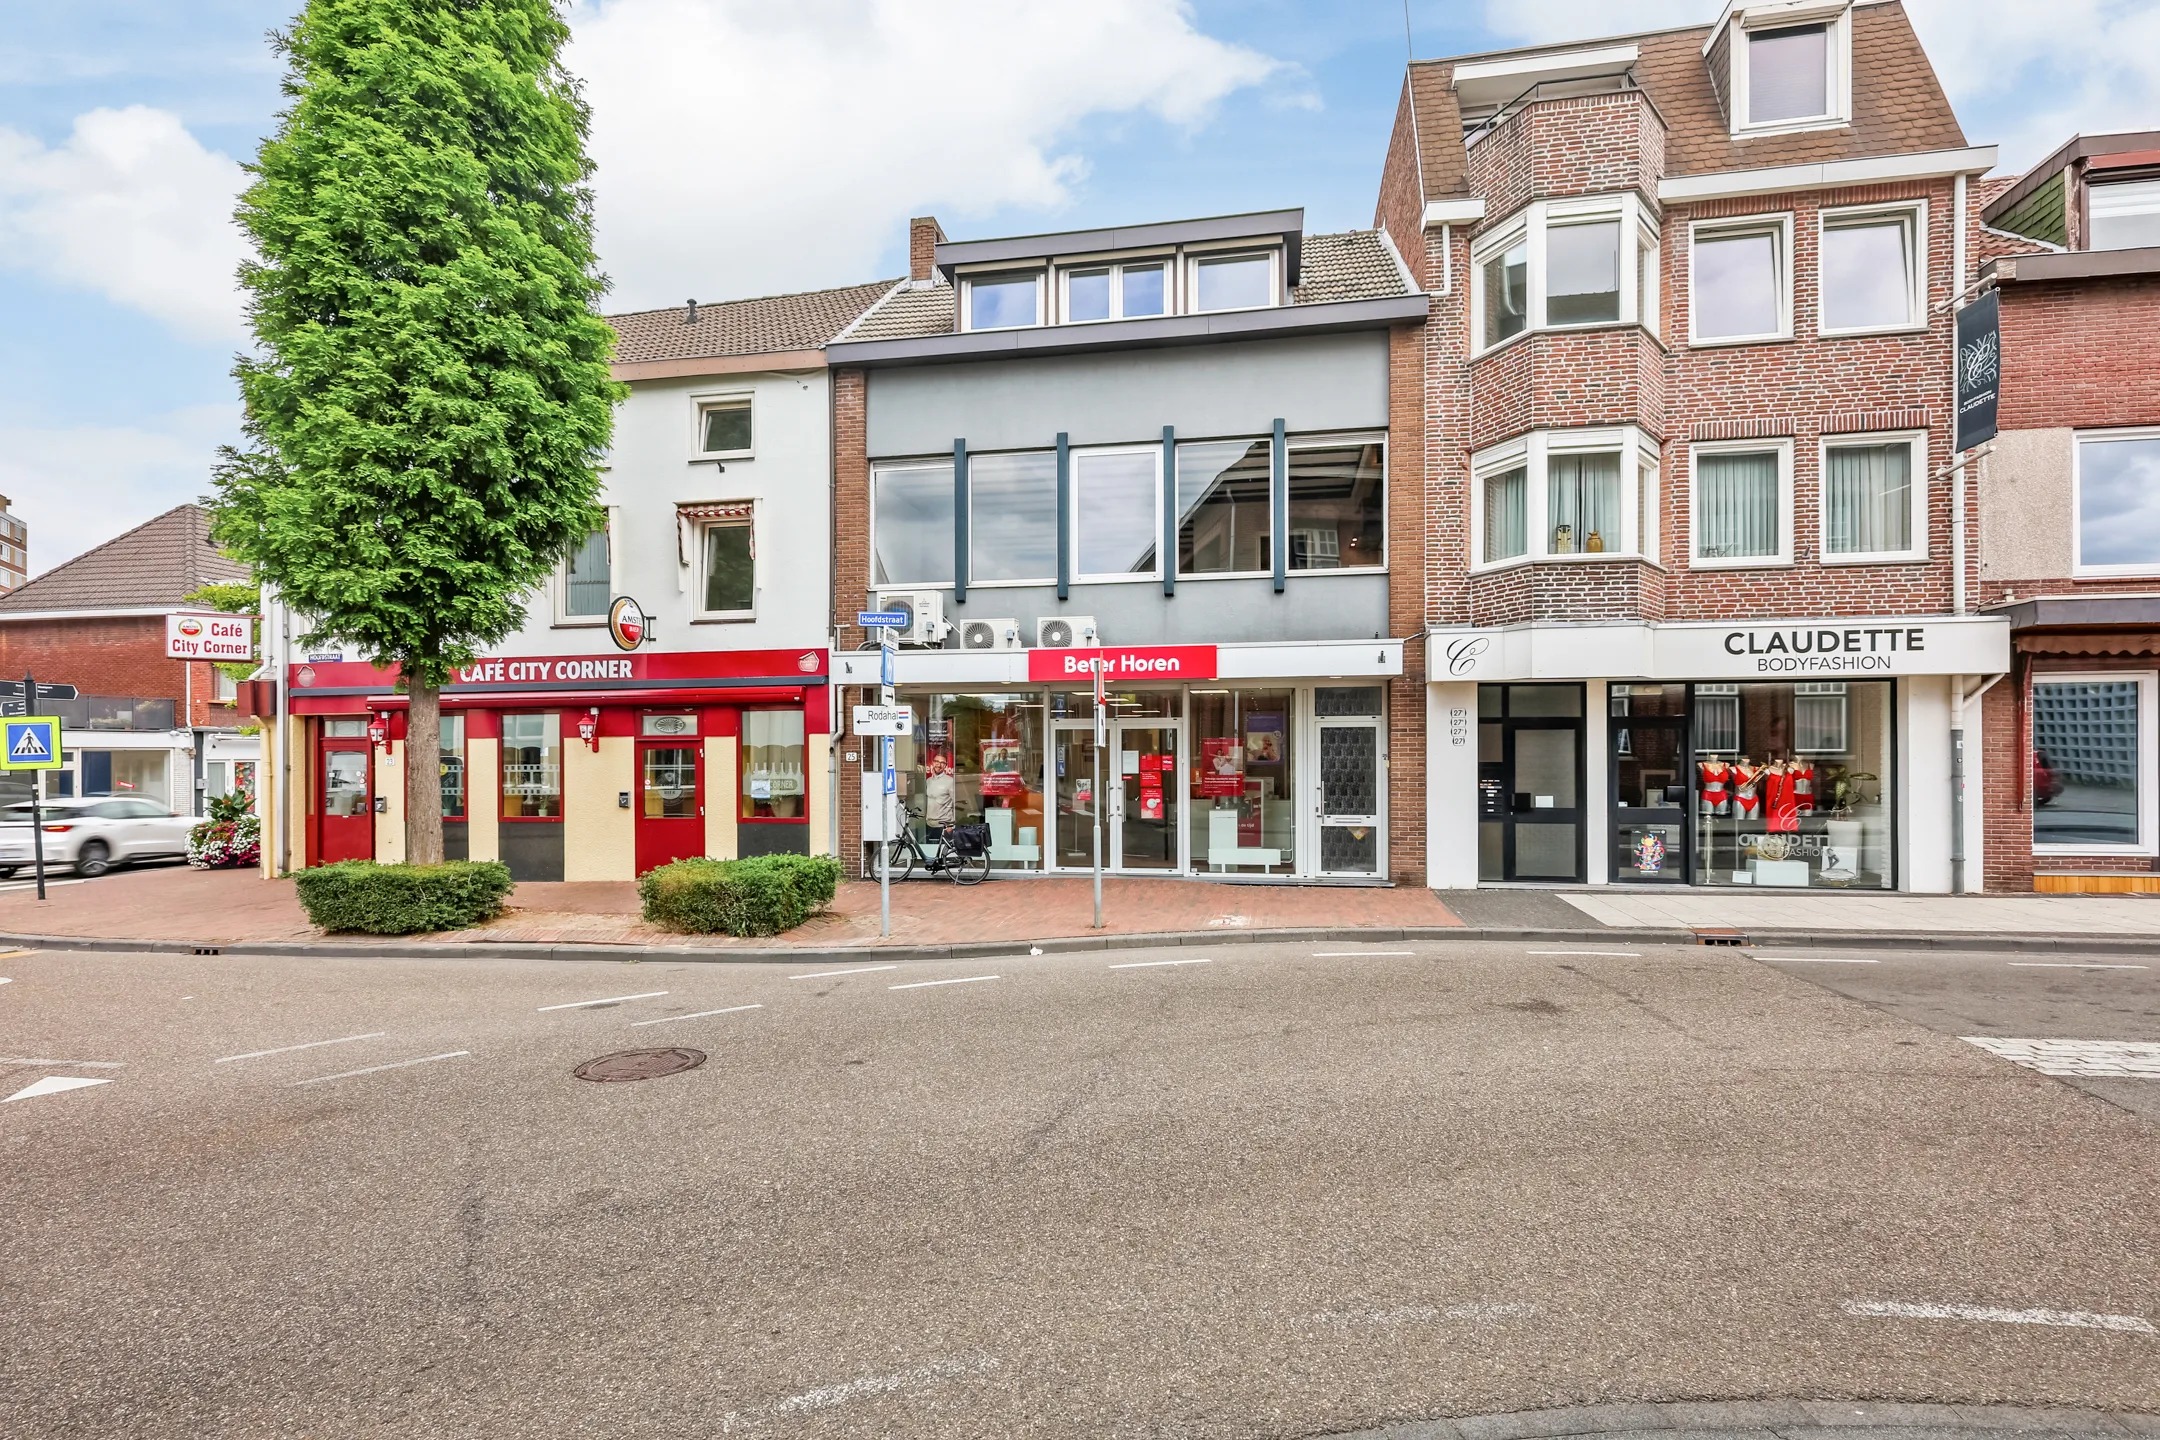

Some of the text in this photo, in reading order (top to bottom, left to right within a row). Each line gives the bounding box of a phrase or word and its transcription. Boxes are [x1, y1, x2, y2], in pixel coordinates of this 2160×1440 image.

[1959, 392, 1996, 414] CLAUDETTE
[861, 615, 904, 624] Hoofdstraat
[211, 623, 243, 637] Café
[172, 639, 247, 655] City Corner
[1724, 628, 1925, 655] CLAUDETTE
[1064, 655, 1180, 673] Beter Horen
[1446, 638, 1490, 676] C
[1758, 656, 1891, 671] BODYFASHION
[460, 659, 633, 682] CAFÉ CITY CORNER
[868, 711, 898, 720] Rodahal
[847, 753, 857, 761] 25
